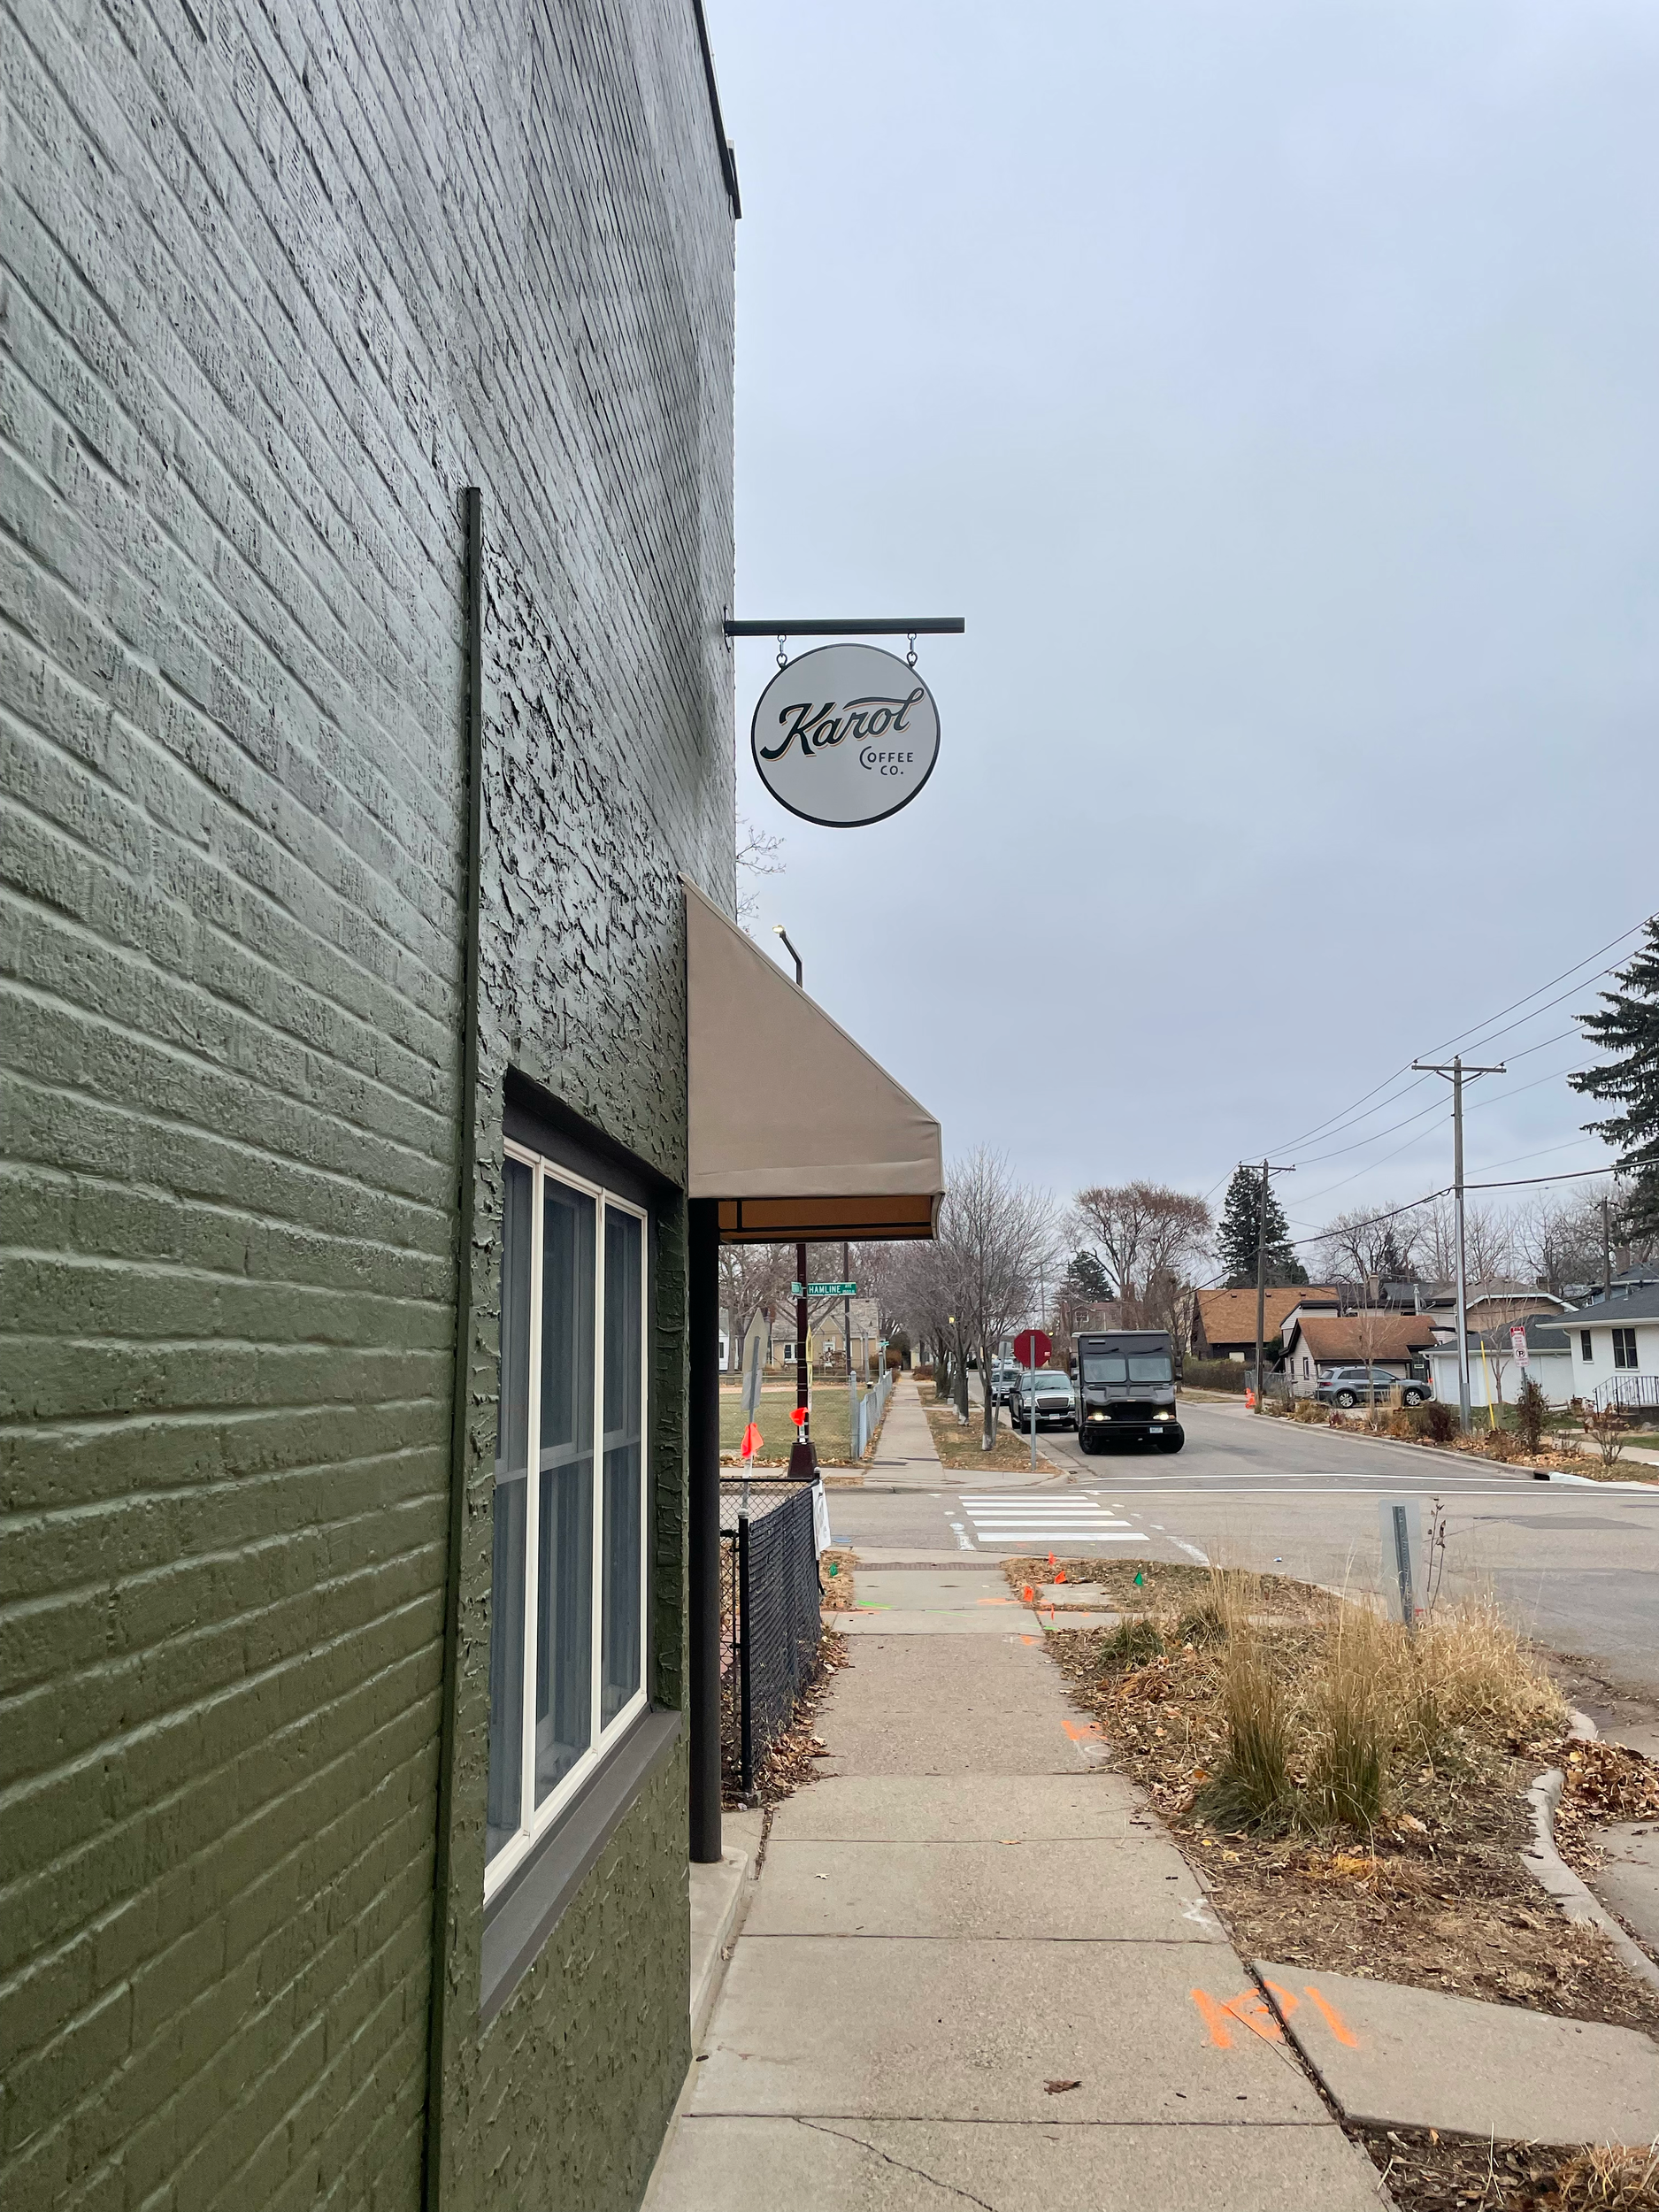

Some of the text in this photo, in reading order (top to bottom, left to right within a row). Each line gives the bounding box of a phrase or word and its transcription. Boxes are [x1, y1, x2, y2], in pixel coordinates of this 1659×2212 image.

[760, 687, 926, 762] Karol
[859, 746, 914, 770] COFFEE
[880, 765, 904, 776] CO.
